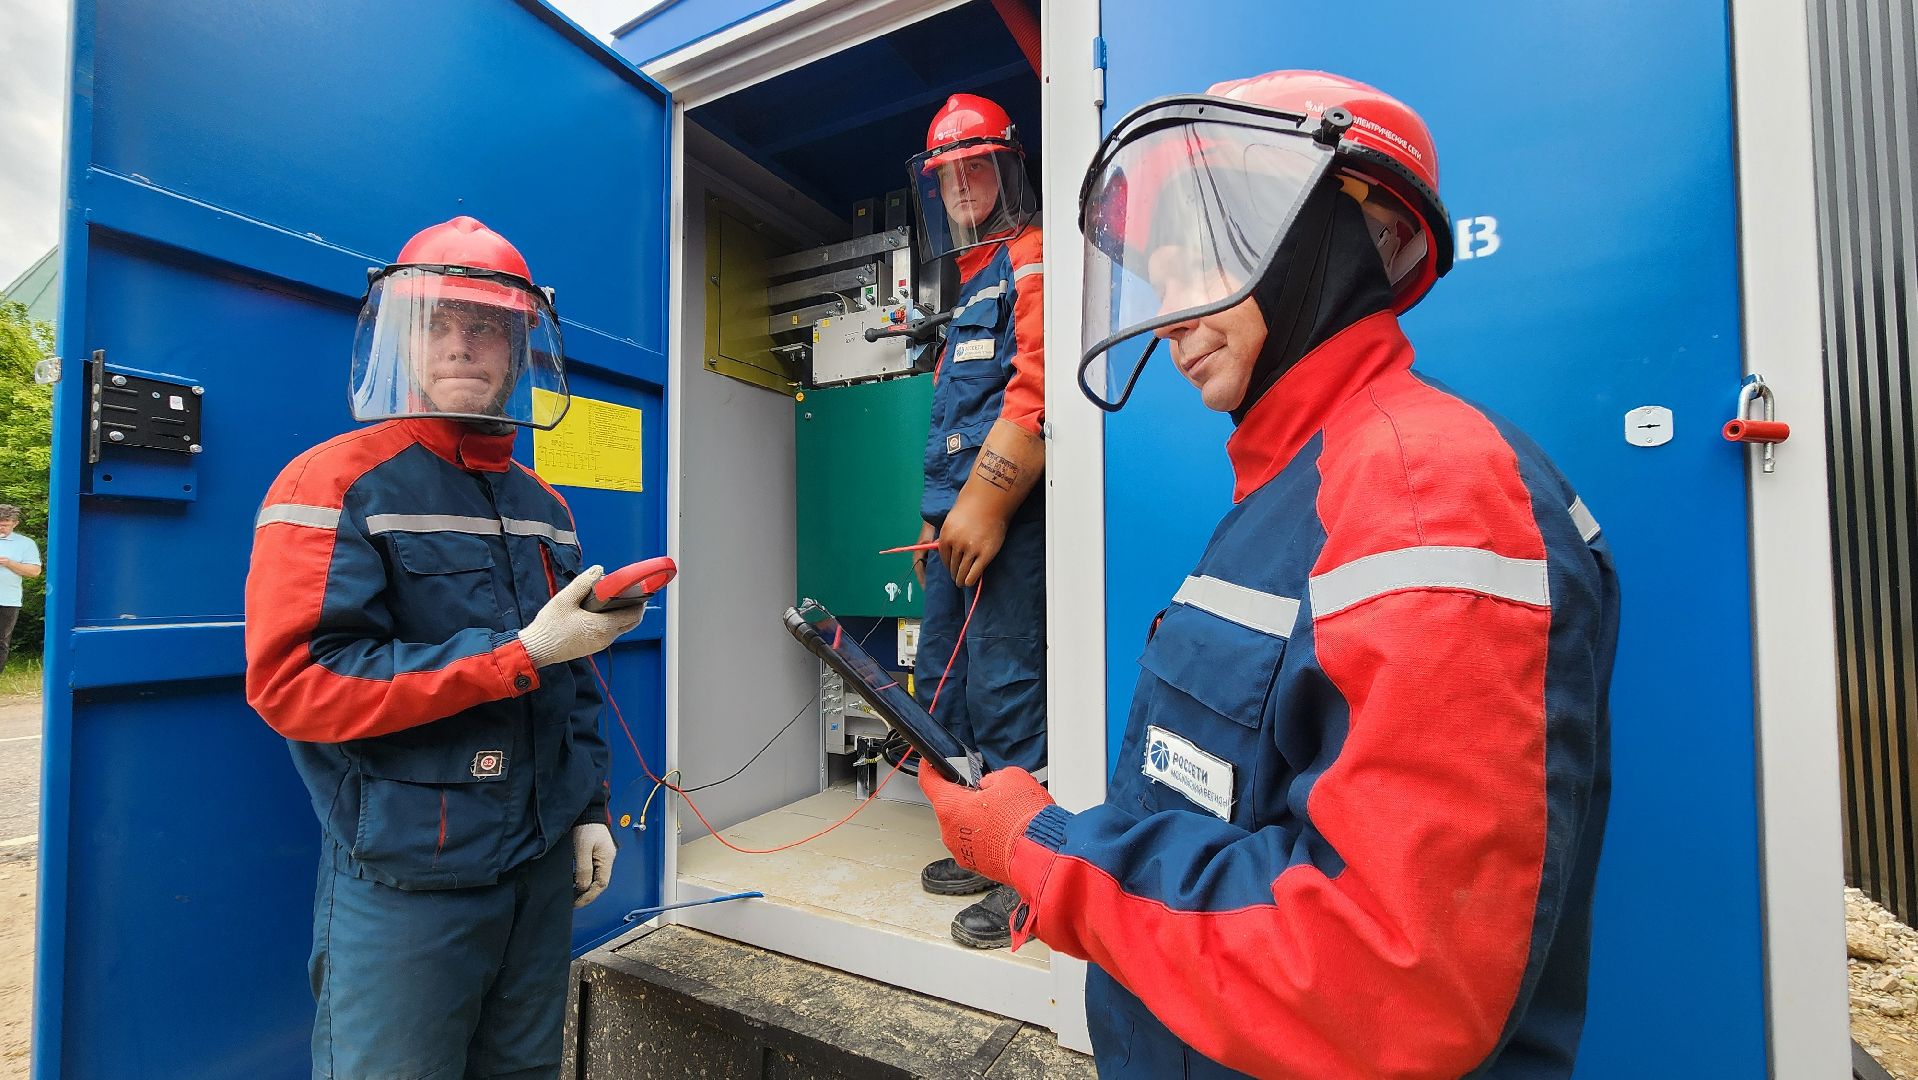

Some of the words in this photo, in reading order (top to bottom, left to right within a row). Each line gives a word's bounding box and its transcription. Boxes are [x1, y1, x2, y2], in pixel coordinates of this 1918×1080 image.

[1407, 144, 1422, 160] СЕТИ
[1453, 215, 1501, 262] В
[1172, 751, 1208, 787] РОССЕТИ
